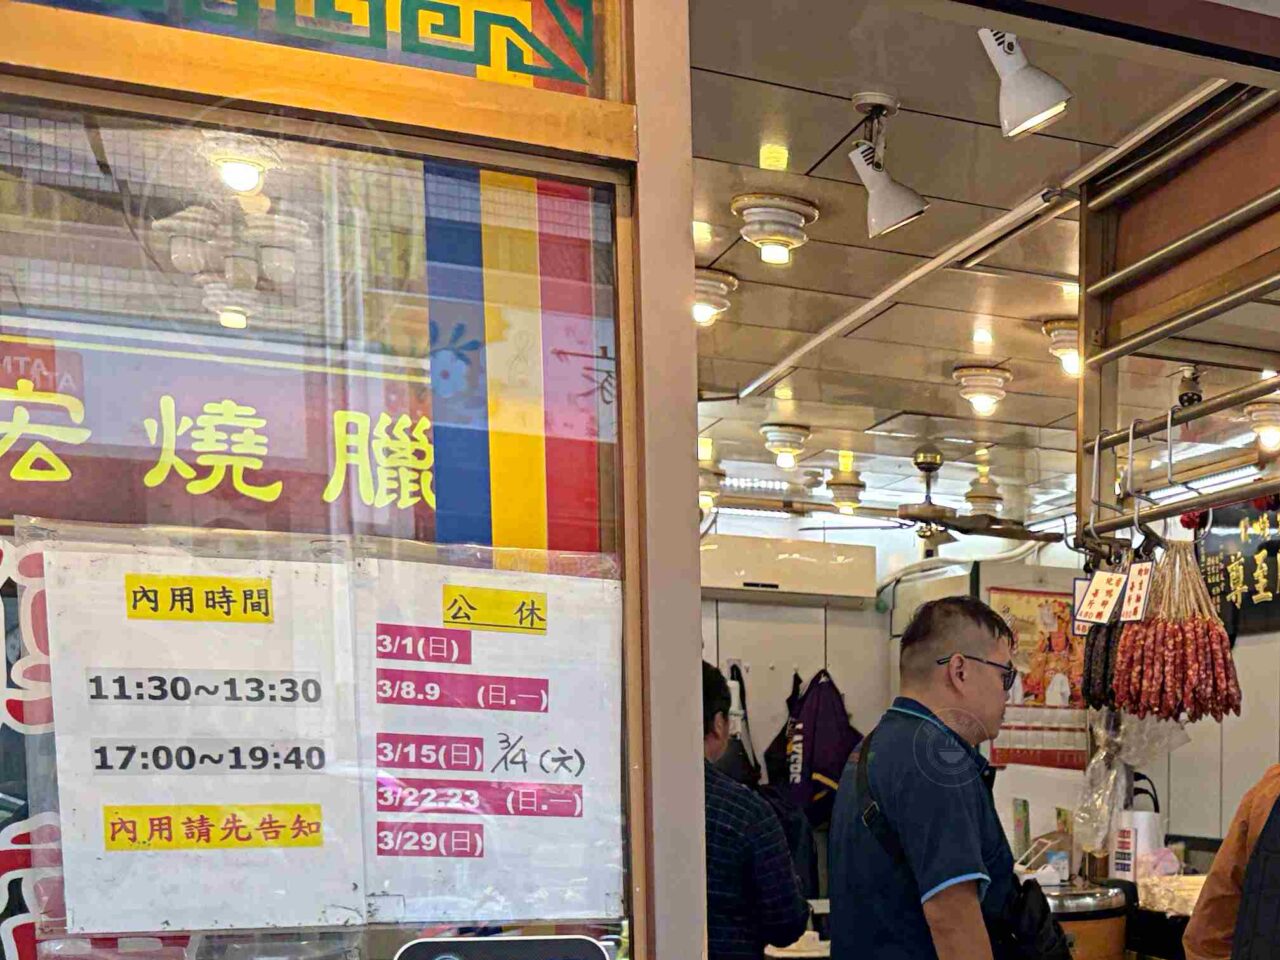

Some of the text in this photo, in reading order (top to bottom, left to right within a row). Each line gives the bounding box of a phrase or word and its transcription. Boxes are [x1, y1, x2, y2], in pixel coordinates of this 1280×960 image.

[131, 585, 270, 617] 內用時間
[377, 635, 459, 662] 3/1(日)
[88, 675, 322, 703] 11:30~13:30
[377, 679, 441, 701] 3/8.9
[94, 745, 327, 771] 17:00~19:40
[377, 741, 483, 770] 3/15(日)
[377, 786, 480, 809] 3/22.23
[110, 813, 321, 843] 內用請先告知
[378, 830, 483, 856] 3/29(日)
